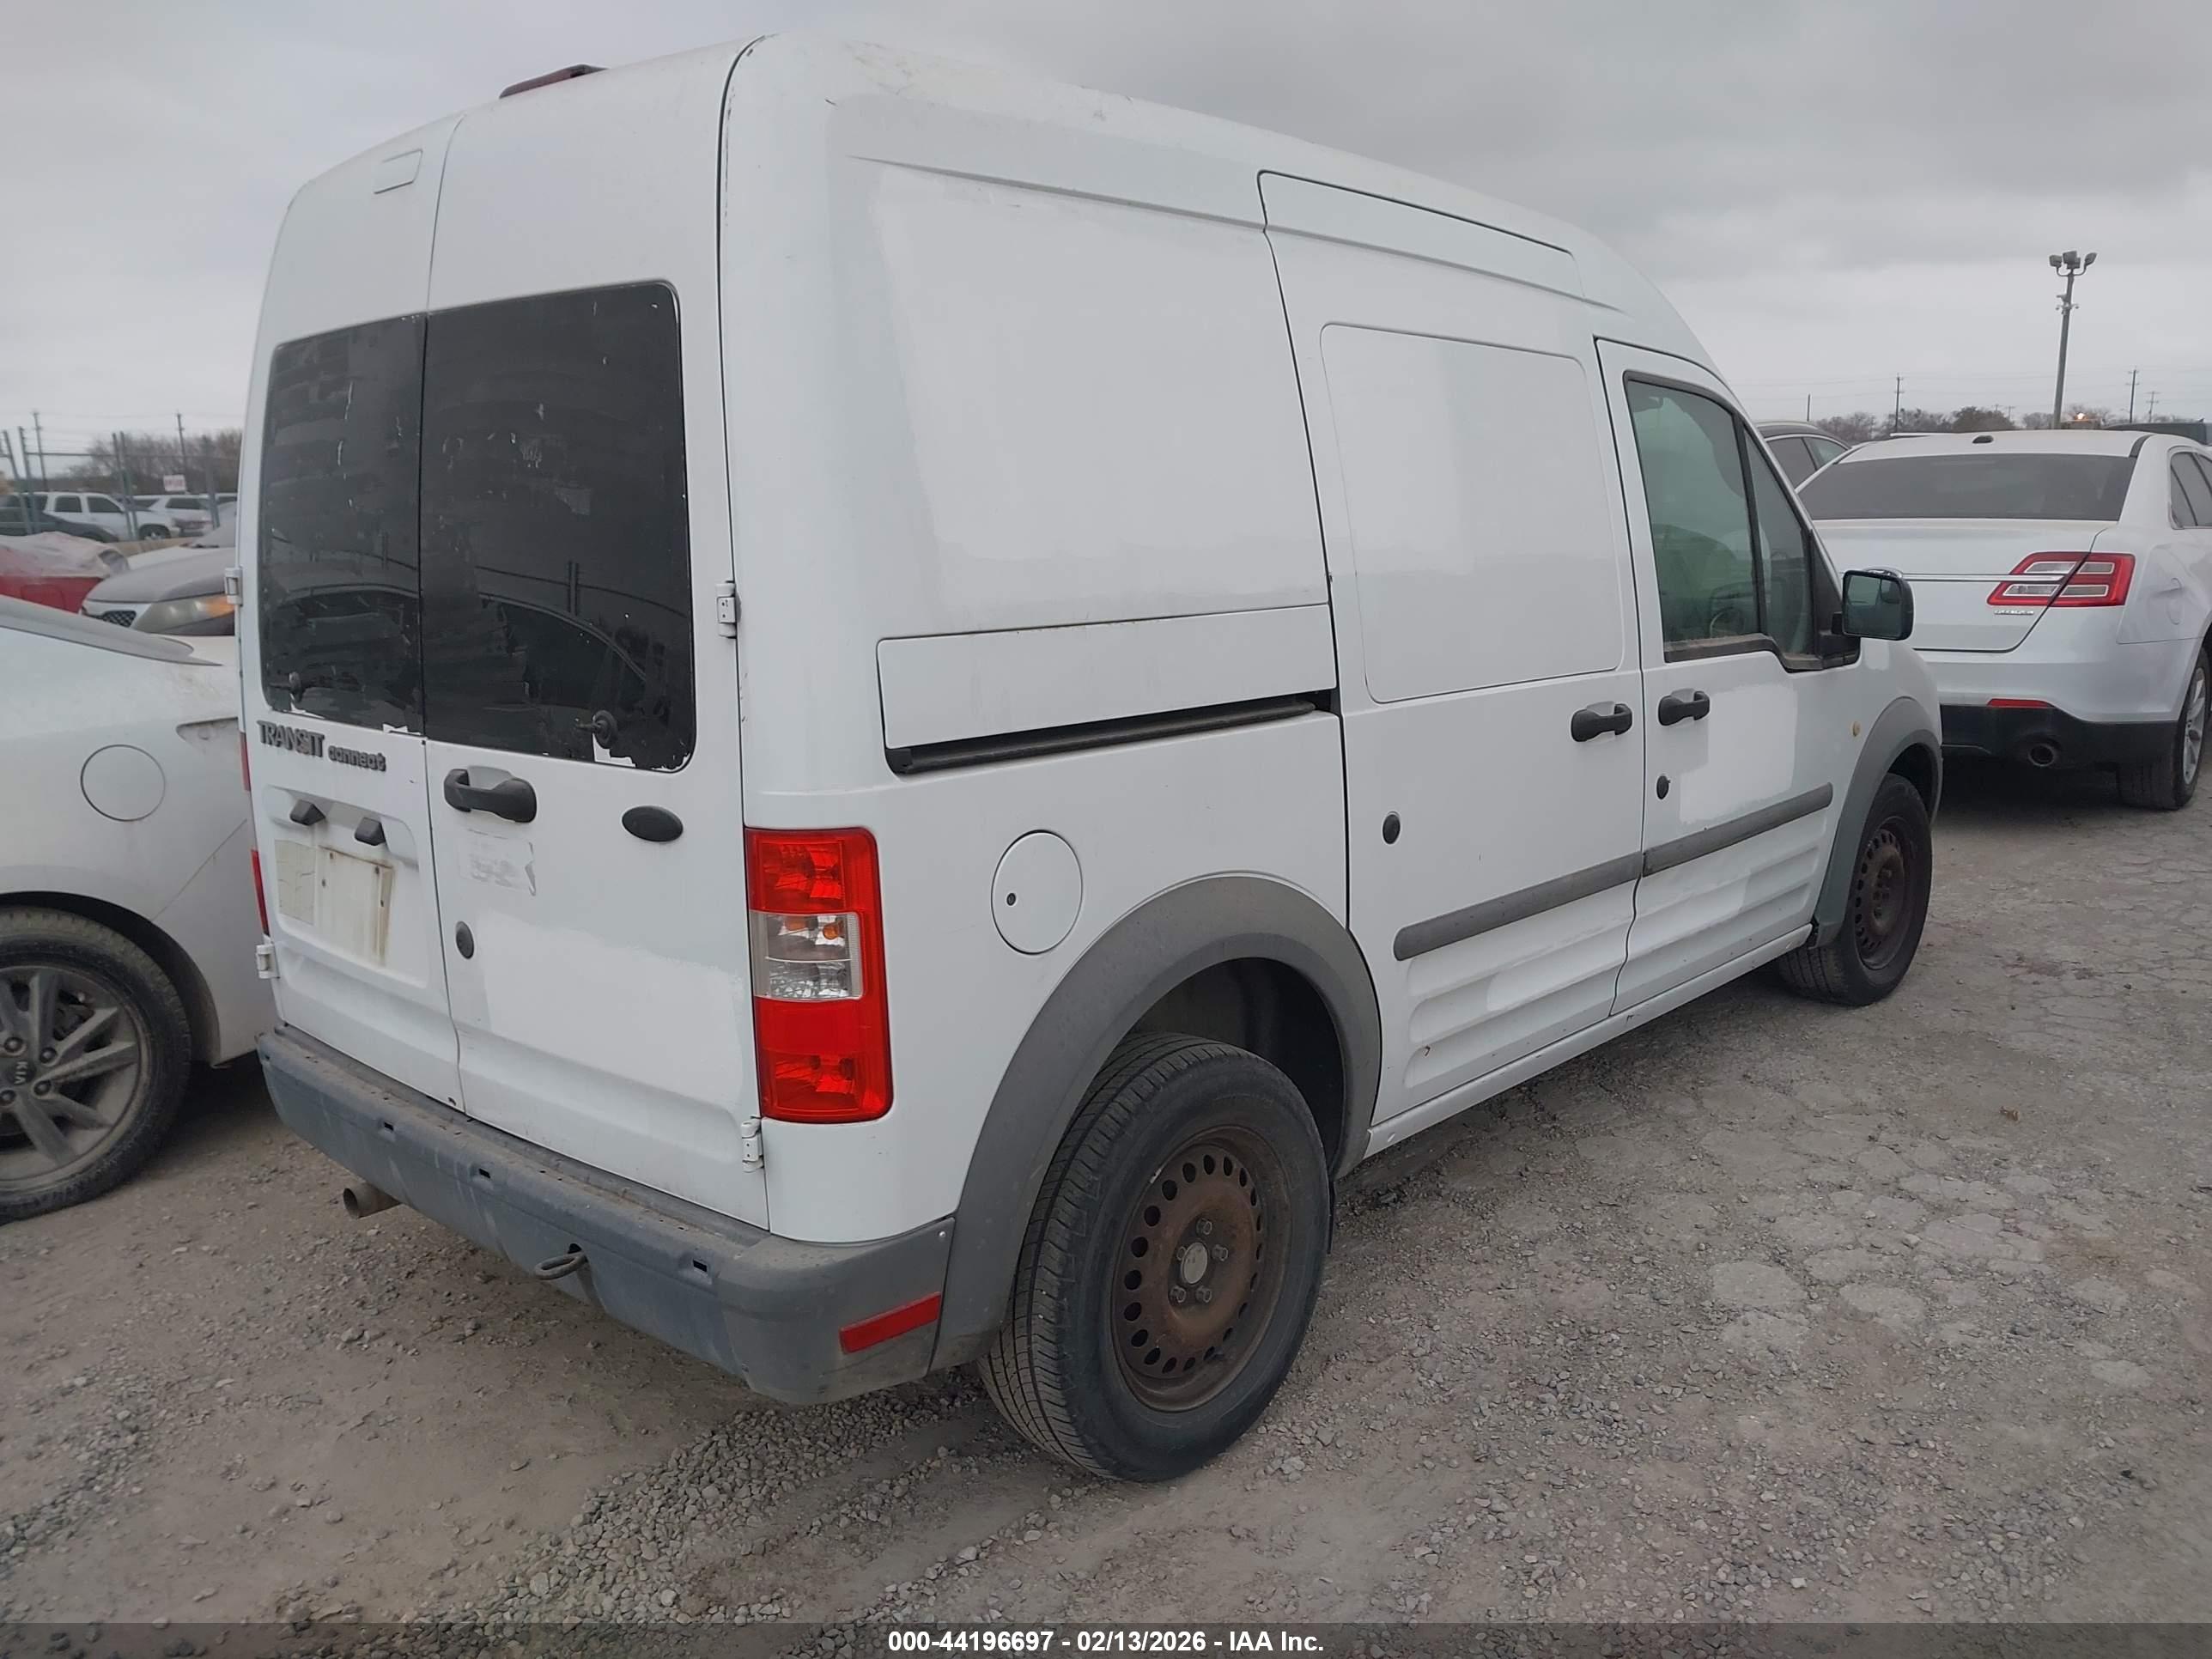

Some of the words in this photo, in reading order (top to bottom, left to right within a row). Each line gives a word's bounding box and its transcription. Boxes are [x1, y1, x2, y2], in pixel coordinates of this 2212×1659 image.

[257, 720, 325, 757] TRANSIT
[328, 744, 386, 772] connect
[15, 1061, 28, 1085] KIA
